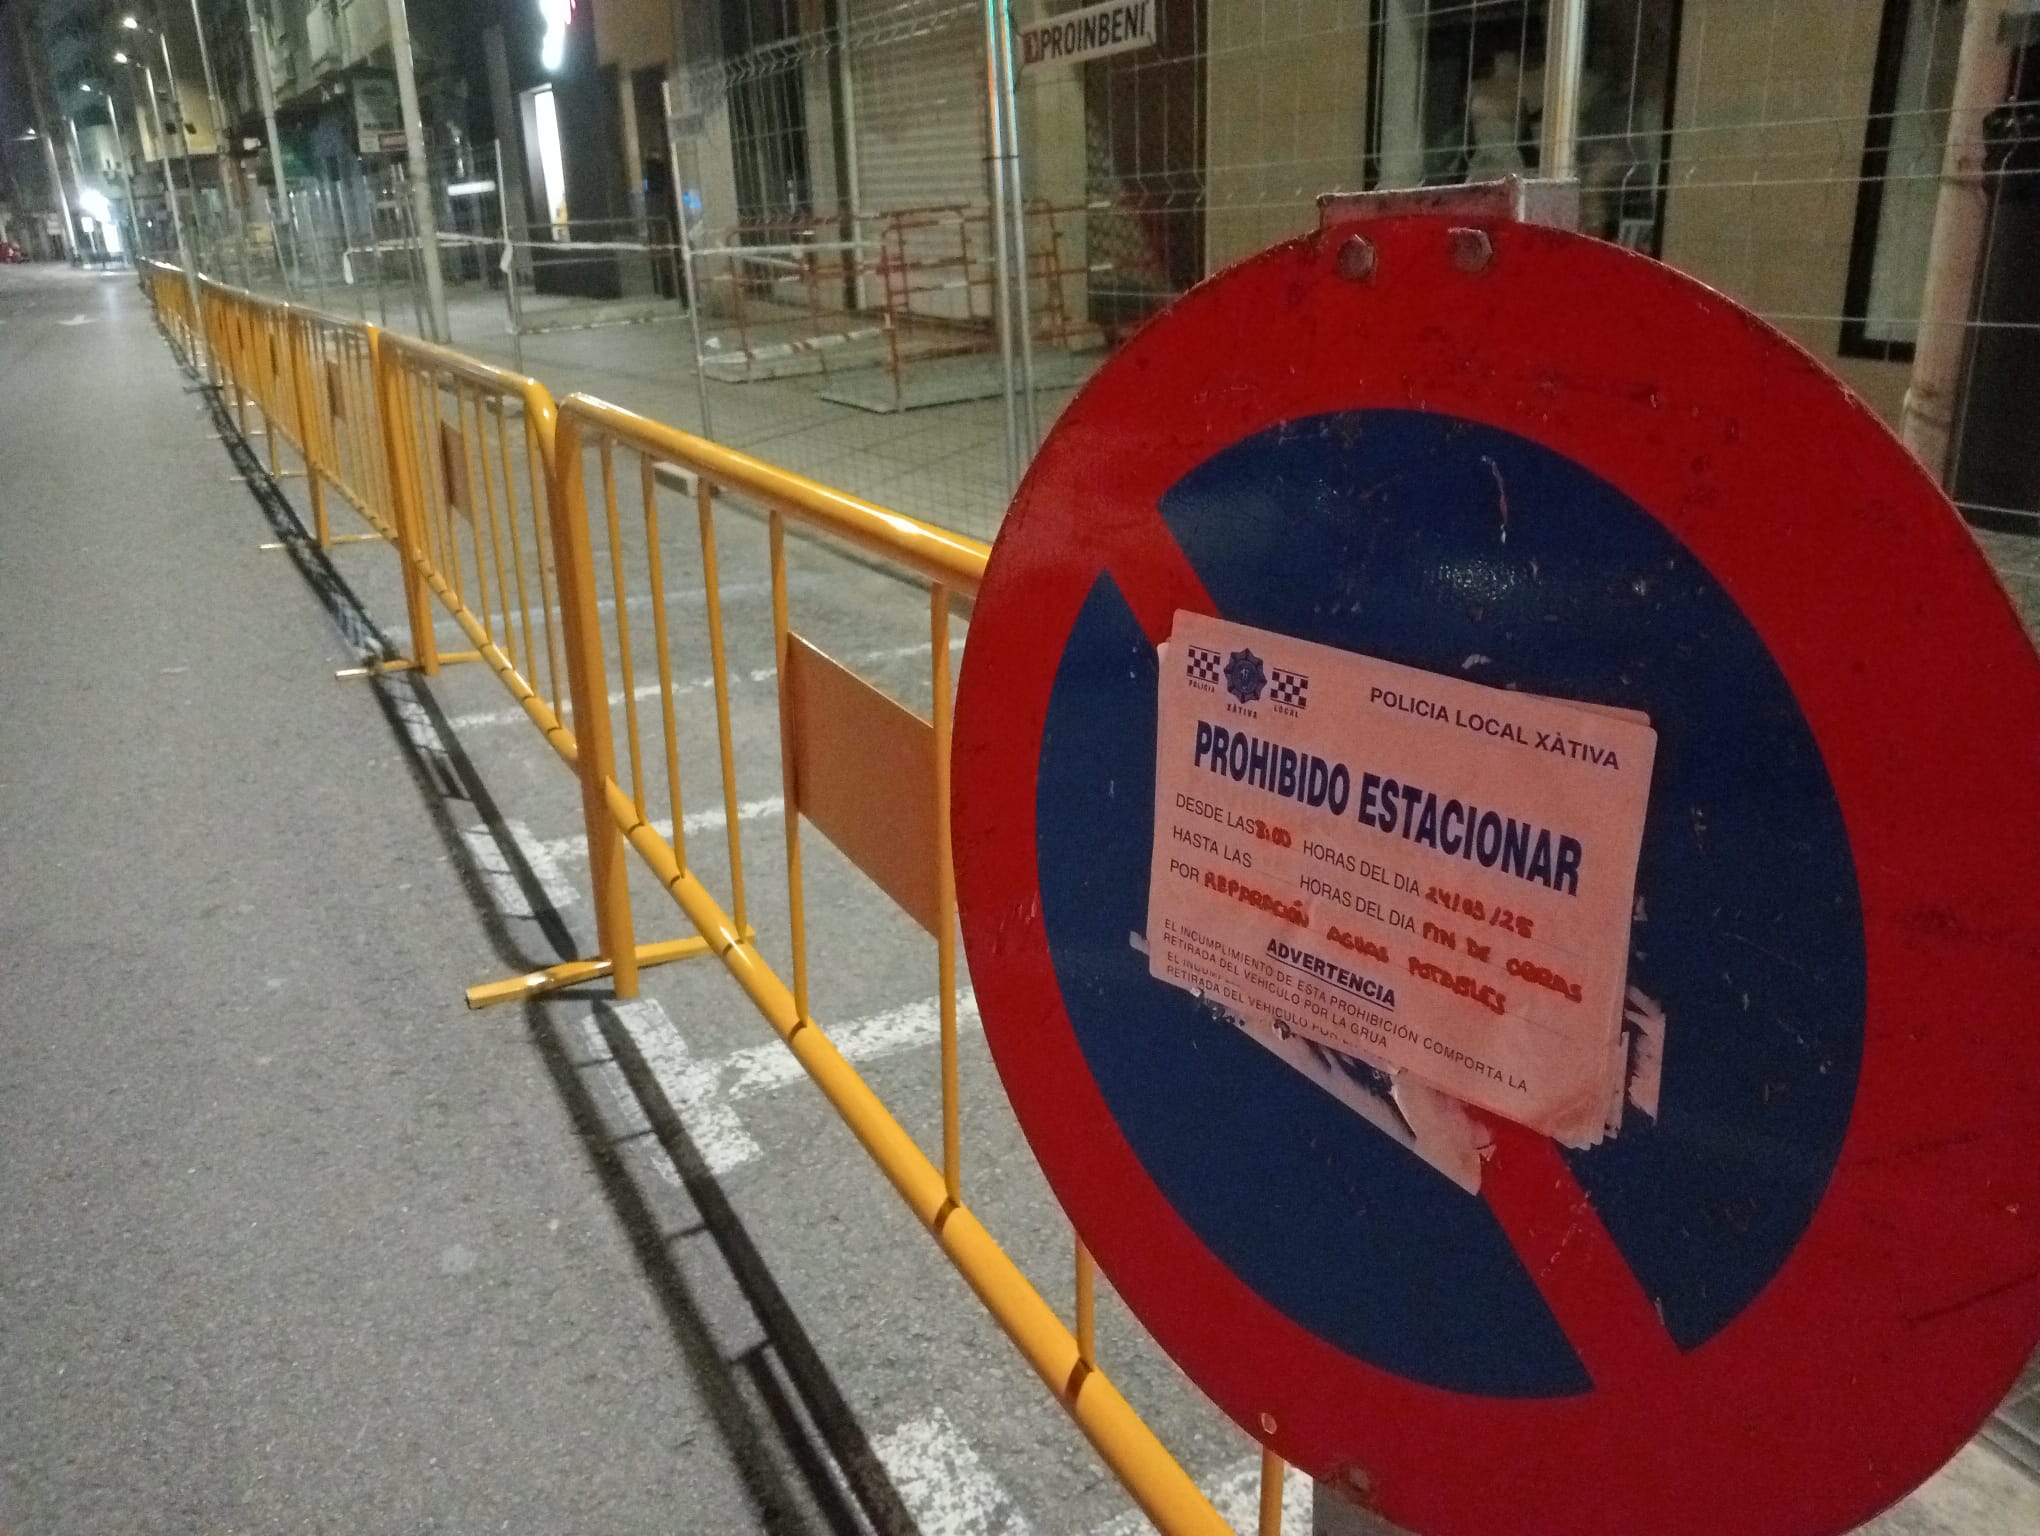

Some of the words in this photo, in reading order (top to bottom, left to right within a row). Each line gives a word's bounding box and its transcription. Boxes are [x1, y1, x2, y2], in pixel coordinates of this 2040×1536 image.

[1274, 705, 1299, 718] LOCAL
[1370, 687, 1449, 722] POLICIA
[1456, 710, 1529, 745] LOCAL
[1534, 731, 1620, 770] XÀTIVA
[1176, 792, 1223, 823] DESDE
[1227, 812, 1255, 834] LAS
[1303, 840, 1356, 872] HORAS
[1360, 860, 1390, 885] DEL
[1394, 873, 1420, 896] DIA
[1194, 720, 1350, 816] PROHIBIDO
[1358, 772, 1583, 896] ESTACIONAR
[1170, 859, 1199, 882] POR
[1173, 825, 1219, 855] HASTA
[1223, 844, 1252, 868] LAS
[1300, 874, 1352, 907] HORAS
[1355, 896, 1384, 921] DEL
[1389, 910, 1416, 933] DIA
[1423, 922, 1456, 950] FIN
[1163, 932, 1216, 962] RETIRADA
[1219, 958, 1240, 976] DEL
[1244, 969, 1301, 1005] VEHICULO
[1303, 999, 1329, 1020] POR
[1332, 1013, 1347, 1028] LA
[1350, 1022, 1387, 1048] GRUA
[1167, 951, 1180, 964] EL
[1167, 964, 1221, 993] RETIRADA
[1223, 986, 1244, 1004] DEL
[1267, 938, 1396, 1008] ADVERTENCIA
[1164, 918, 1177, 932] EL
[1181, 926, 1273, 977] INCUMPLIMIENTO
[1276, 971, 1293, 986] DE
[1297, 980, 1327, 1001] ESTA
[1330, 995, 1419, 1044] PROHIBICIÓN
[1423, 1037, 1503, 1082] COMPORTA
[1508, 1075, 1528, 1093] LA
